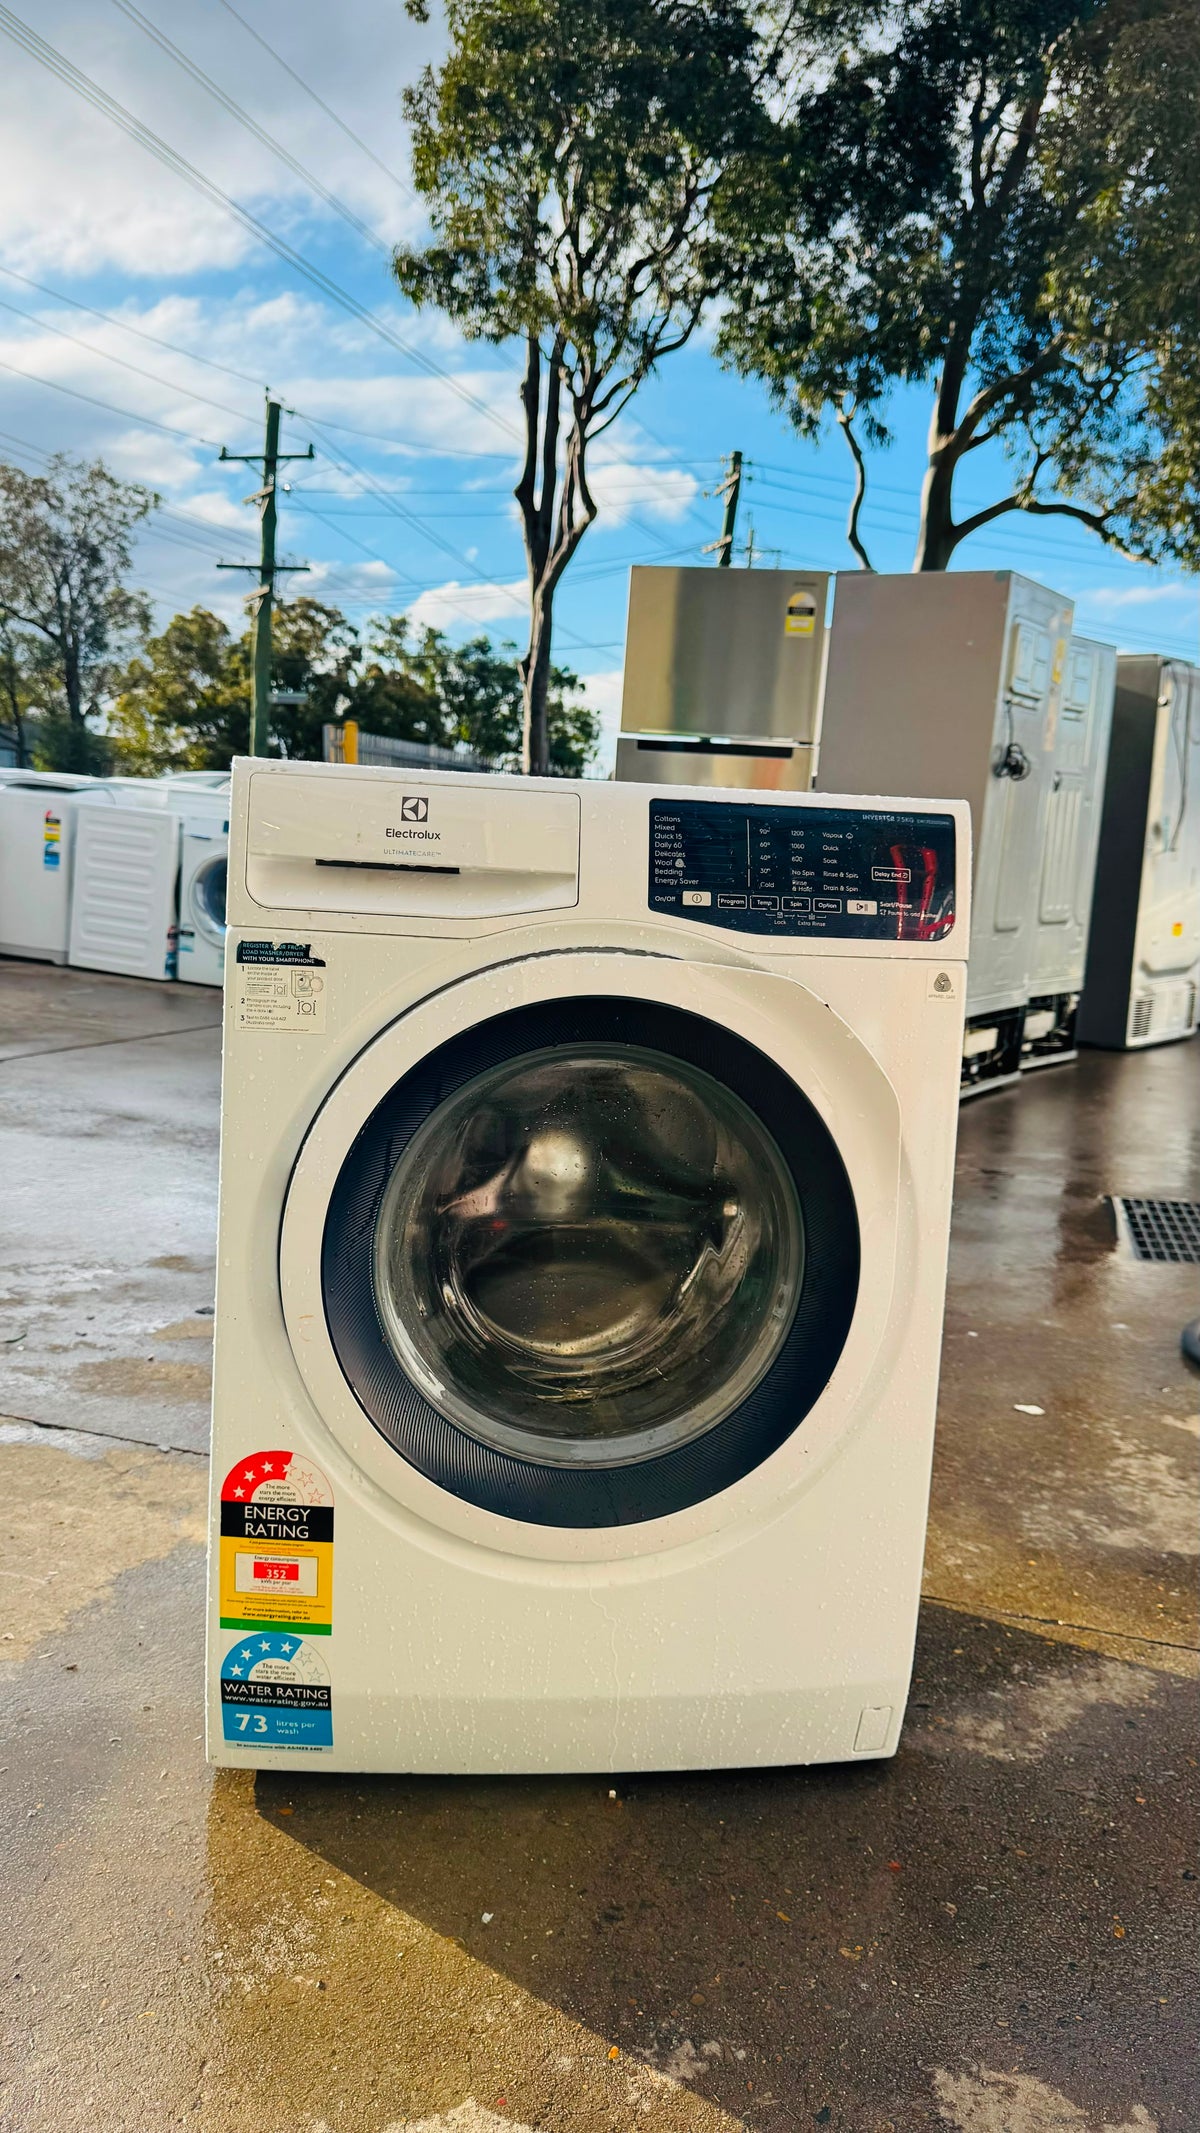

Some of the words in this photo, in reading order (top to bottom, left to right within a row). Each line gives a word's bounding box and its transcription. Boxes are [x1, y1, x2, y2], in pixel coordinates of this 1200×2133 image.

[386, 828, 441, 840] Electrolux
[655, 868, 683, 876] Bedding
[655, 877, 678, 885] Energy
[245, 1506, 311, 1522] ENERGY
[245, 1523, 309, 1539] RATING
[267, 1569, 287, 1579] 352
[224, 1683, 272, 1697] WATER
[277, 1688, 328, 1700] RATING
[225, 1695, 329, 1708] www.waterrating.gov.au
[235, 1713, 268, 1733] 73
[277, 1720, 299, 1728] litres
